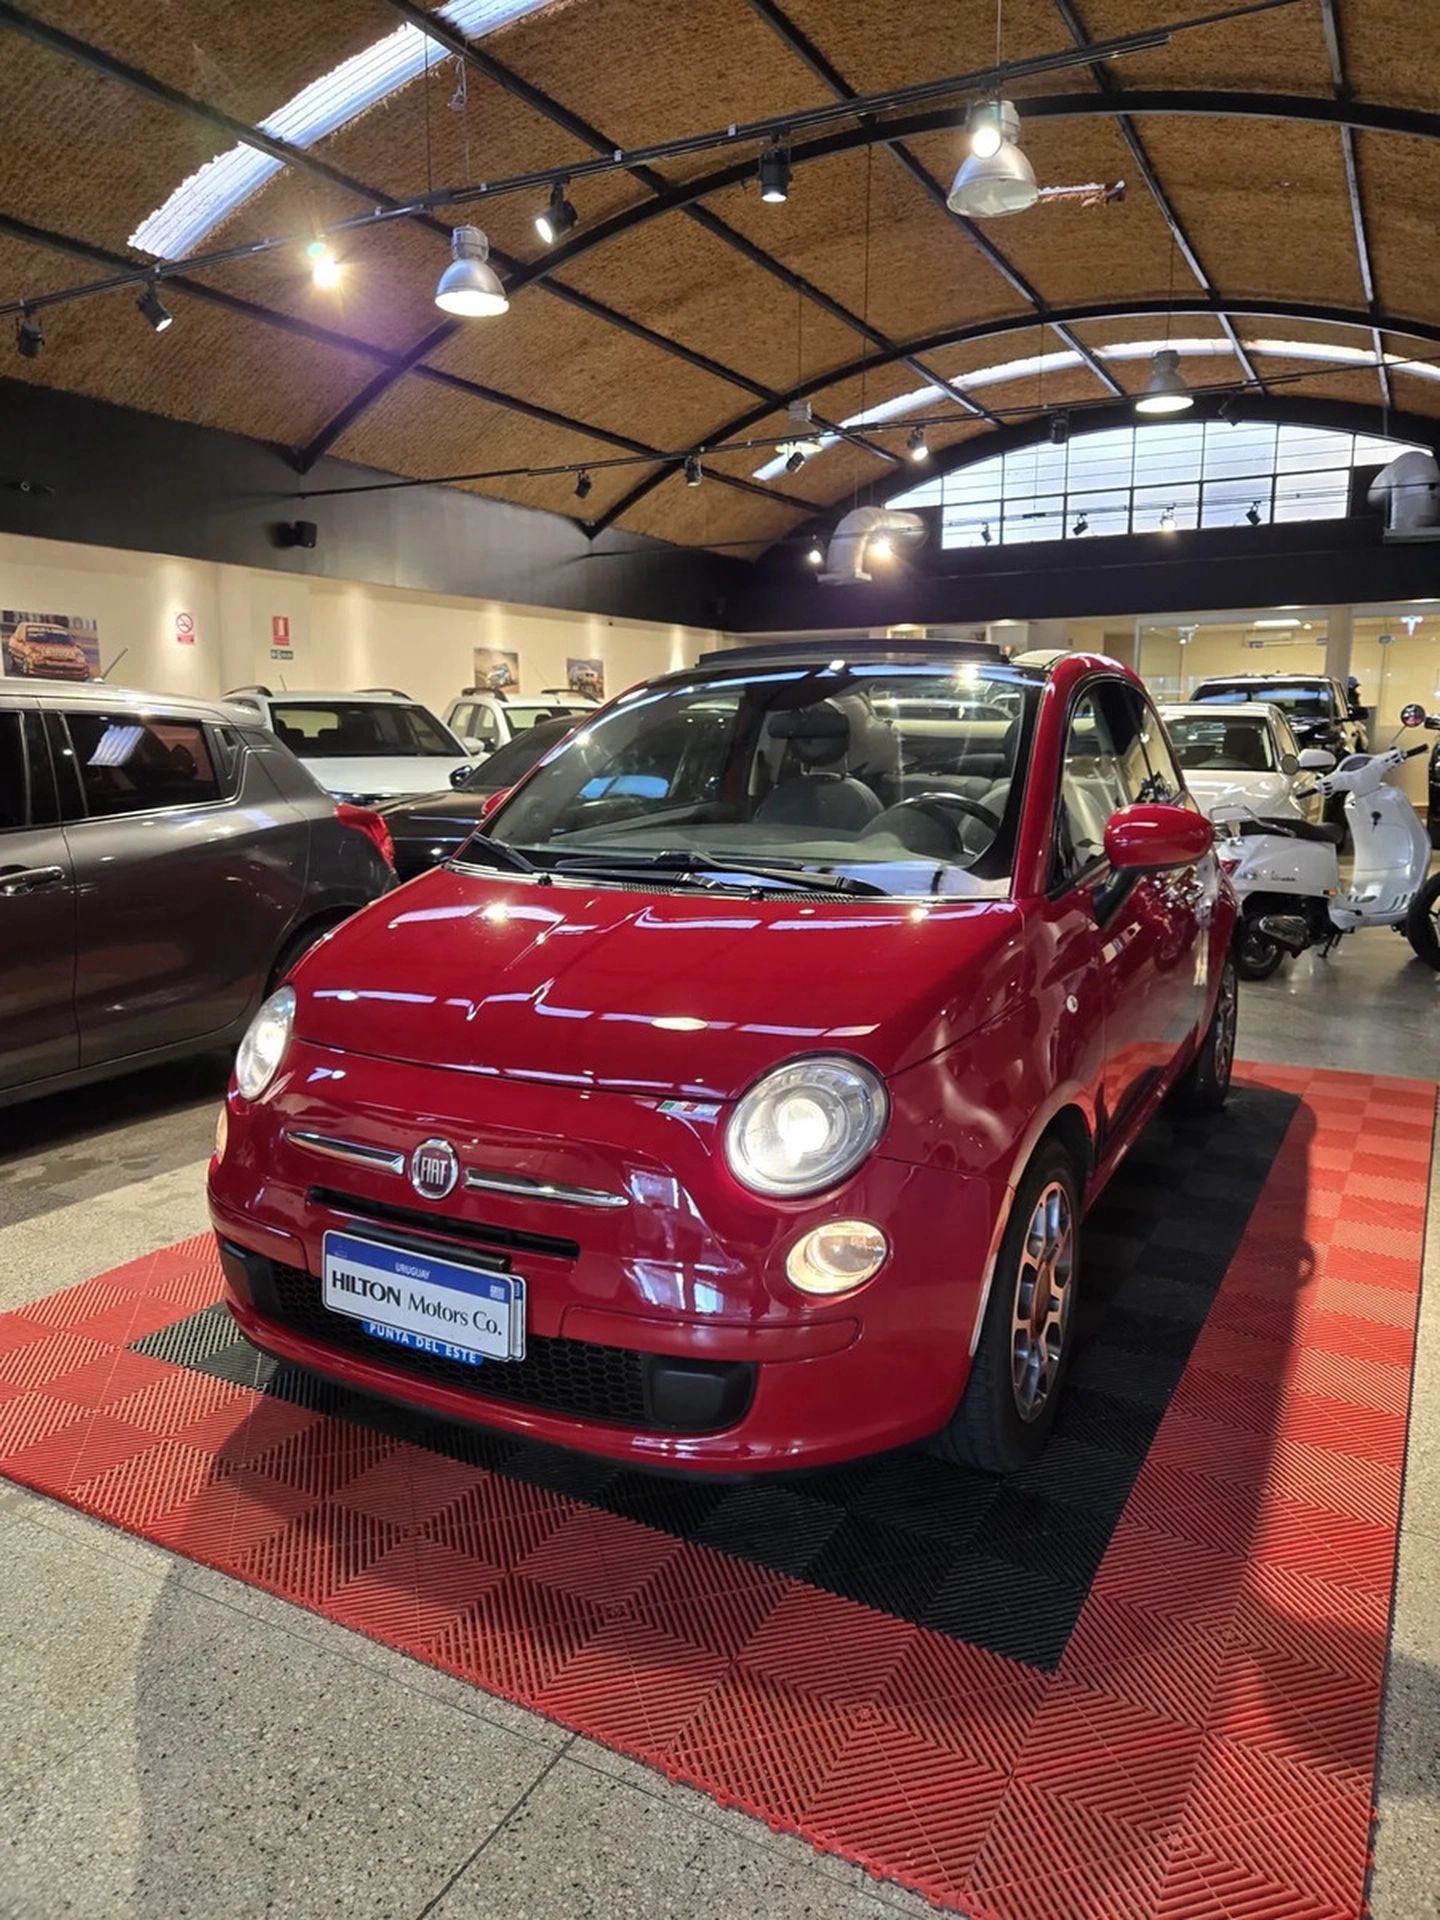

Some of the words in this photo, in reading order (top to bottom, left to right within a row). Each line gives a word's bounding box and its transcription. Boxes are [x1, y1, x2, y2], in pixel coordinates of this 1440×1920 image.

[420, 1156, 448, 1185] FIAT
[395, 1262, 431, 1280] URUGUAY
[332, 1270, 401, 1307] HILTON
[408, 1292, 468, 1327] Motors
[473, 1310, 502, 1336] Co.
[369, 1323, 410, 1345] PUNTA
[416, 1334, 439, 1353] DEL
[446, 1346, 477, 1364] ESTE
